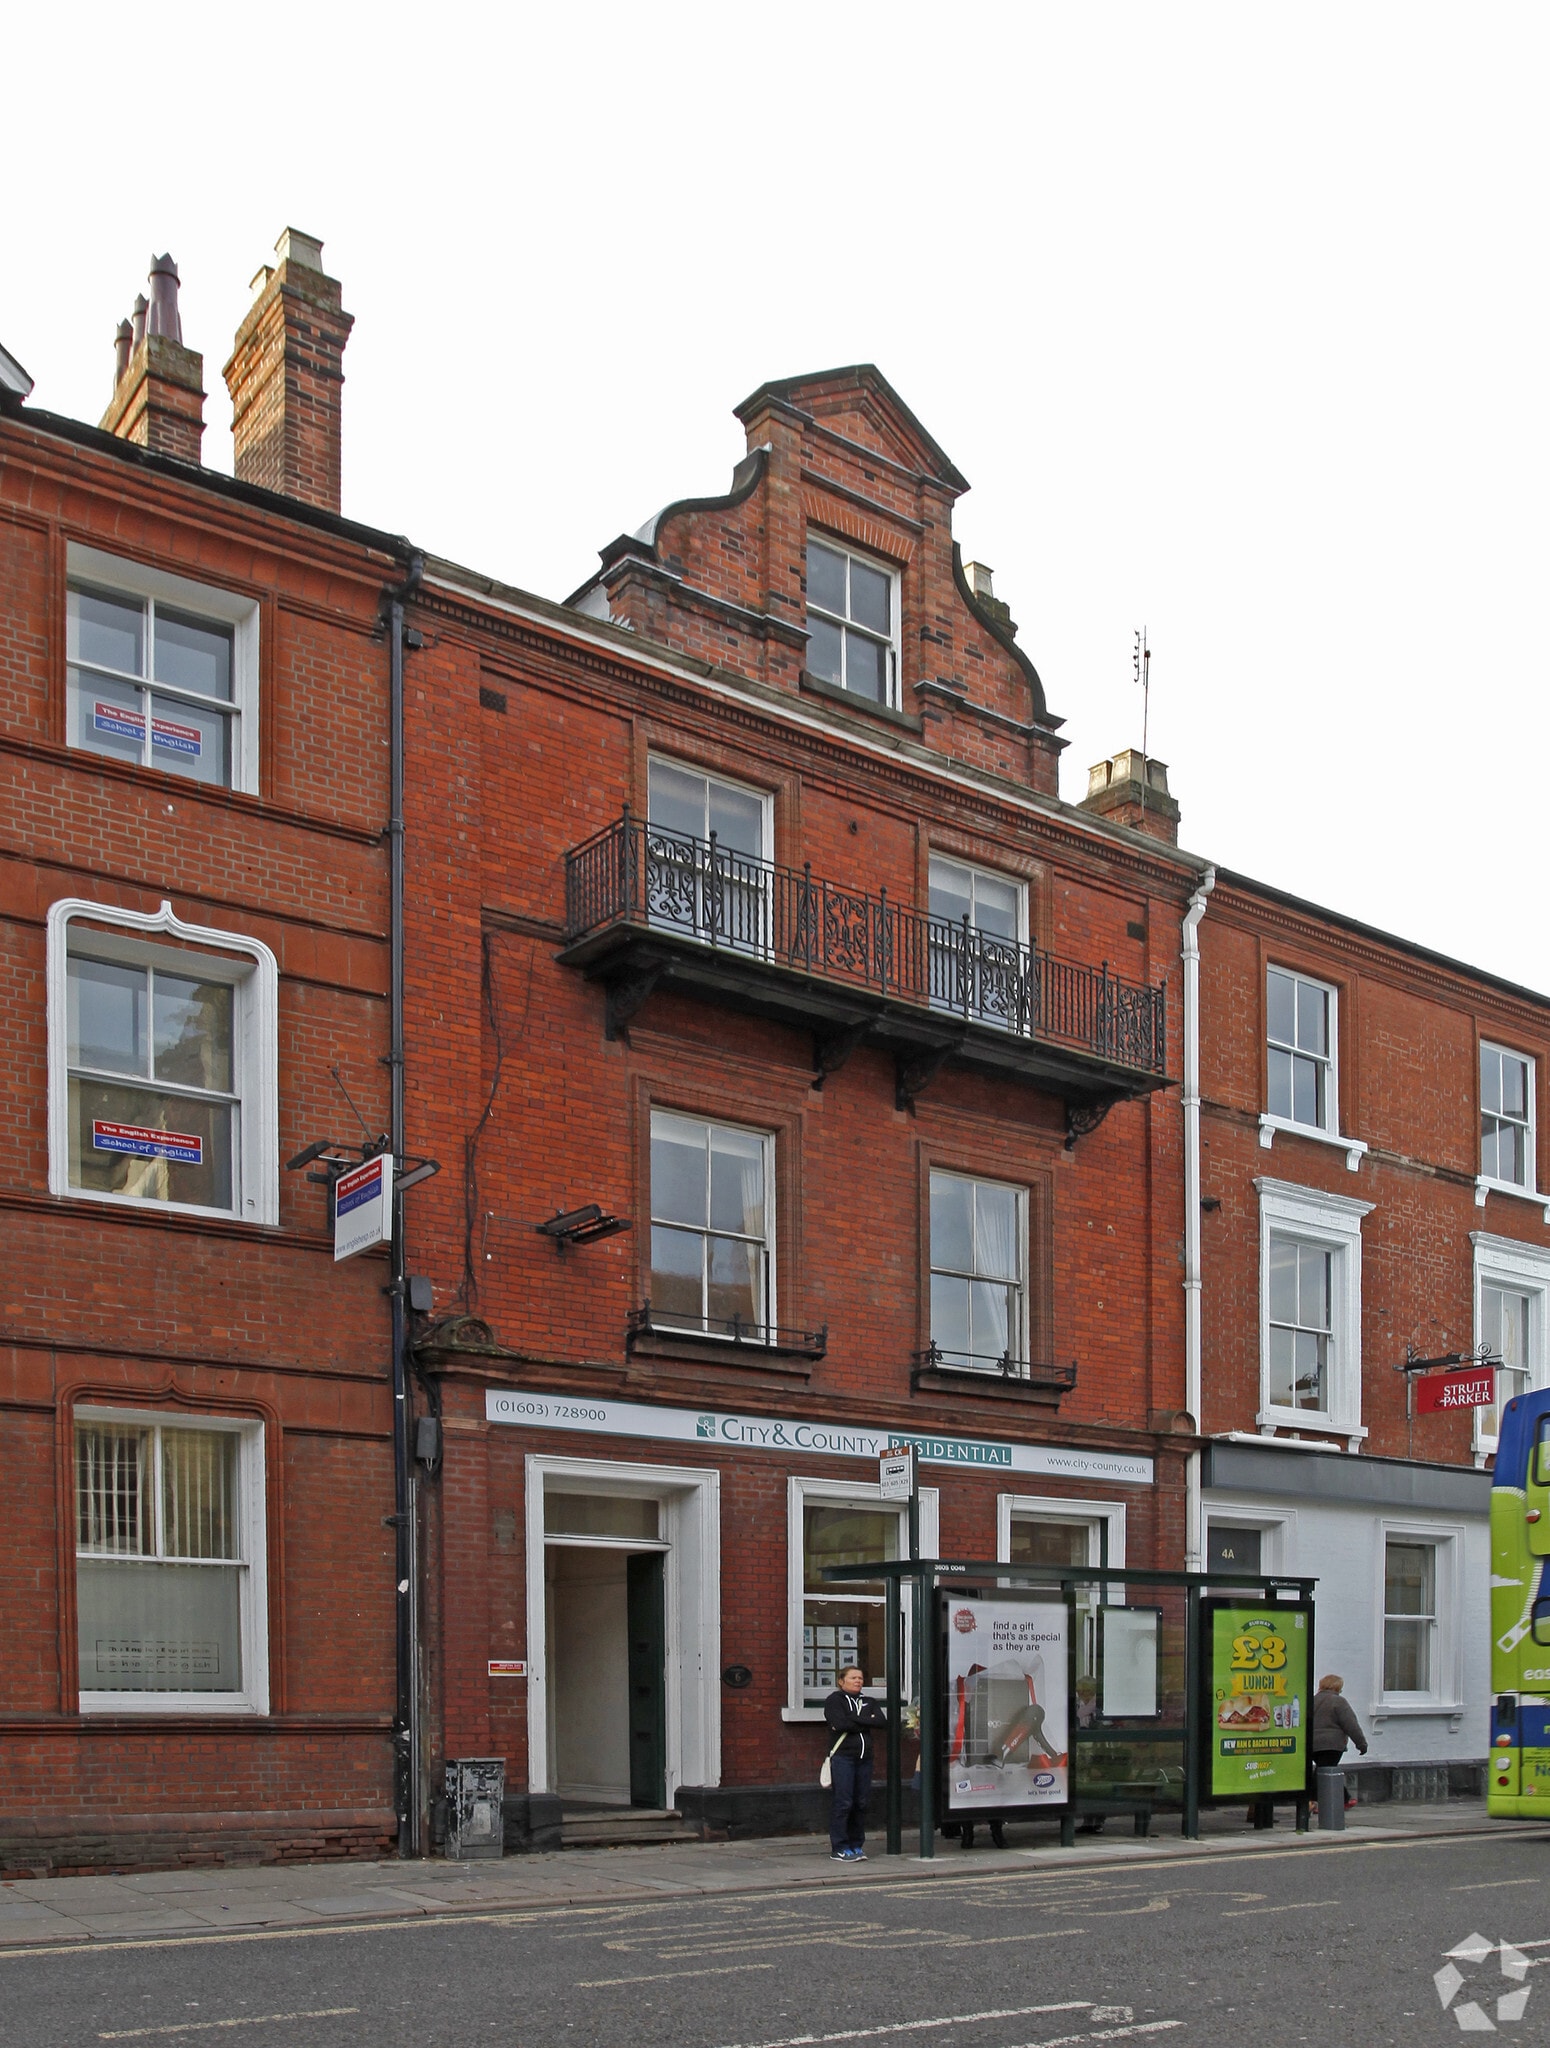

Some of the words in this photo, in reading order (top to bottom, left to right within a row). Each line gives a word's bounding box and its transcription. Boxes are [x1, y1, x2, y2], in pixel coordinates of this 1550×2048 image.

[102, 707, 117, 716] The
[120, 712, 147, 724] Englis
[101, 720, 136, 735] School
[154, 735, 195, 750] English
[102, 1125, 116, 1133] The
[120, 1128, 149, 1138] English
[151, 1133, 195, 1146] Experience
[101, 1138, 136, 1149] School
[140, 1144, 151, 1153] of
[154, 1146, 195, 1159] English
[1444, 1380, 1490, 1396] STRUTT
[1443, 1391, 1491, 1407] PARKER
[495, 1399, 549, 1418] (01603)
[554, 1405, 606, 1422] 728900
[1046, 1456, 1147, 1475] www.city-county.co.uk
[1221, 1548, 1235, 1559] 4A
[993, 1621, 1010, 1631] find
[1019, 1622, 1034, 1632] gift
[992, 1632, 1016, 1641] that's
[1031, 1633, 1061, 1642] special
[992, 1643, 1003, 1651] as
[1005, 1642, 1023, 1652] they
[1230, 1635, 1287, 1671] £3
[1243, 1674, 1275, 1690] LUNCH
[1223, 1740, 1236, 1748] NEW
[1280, 1738, 1292, 1747] MELT
[1245, 1761, 1271, 1770] SUBWAY
